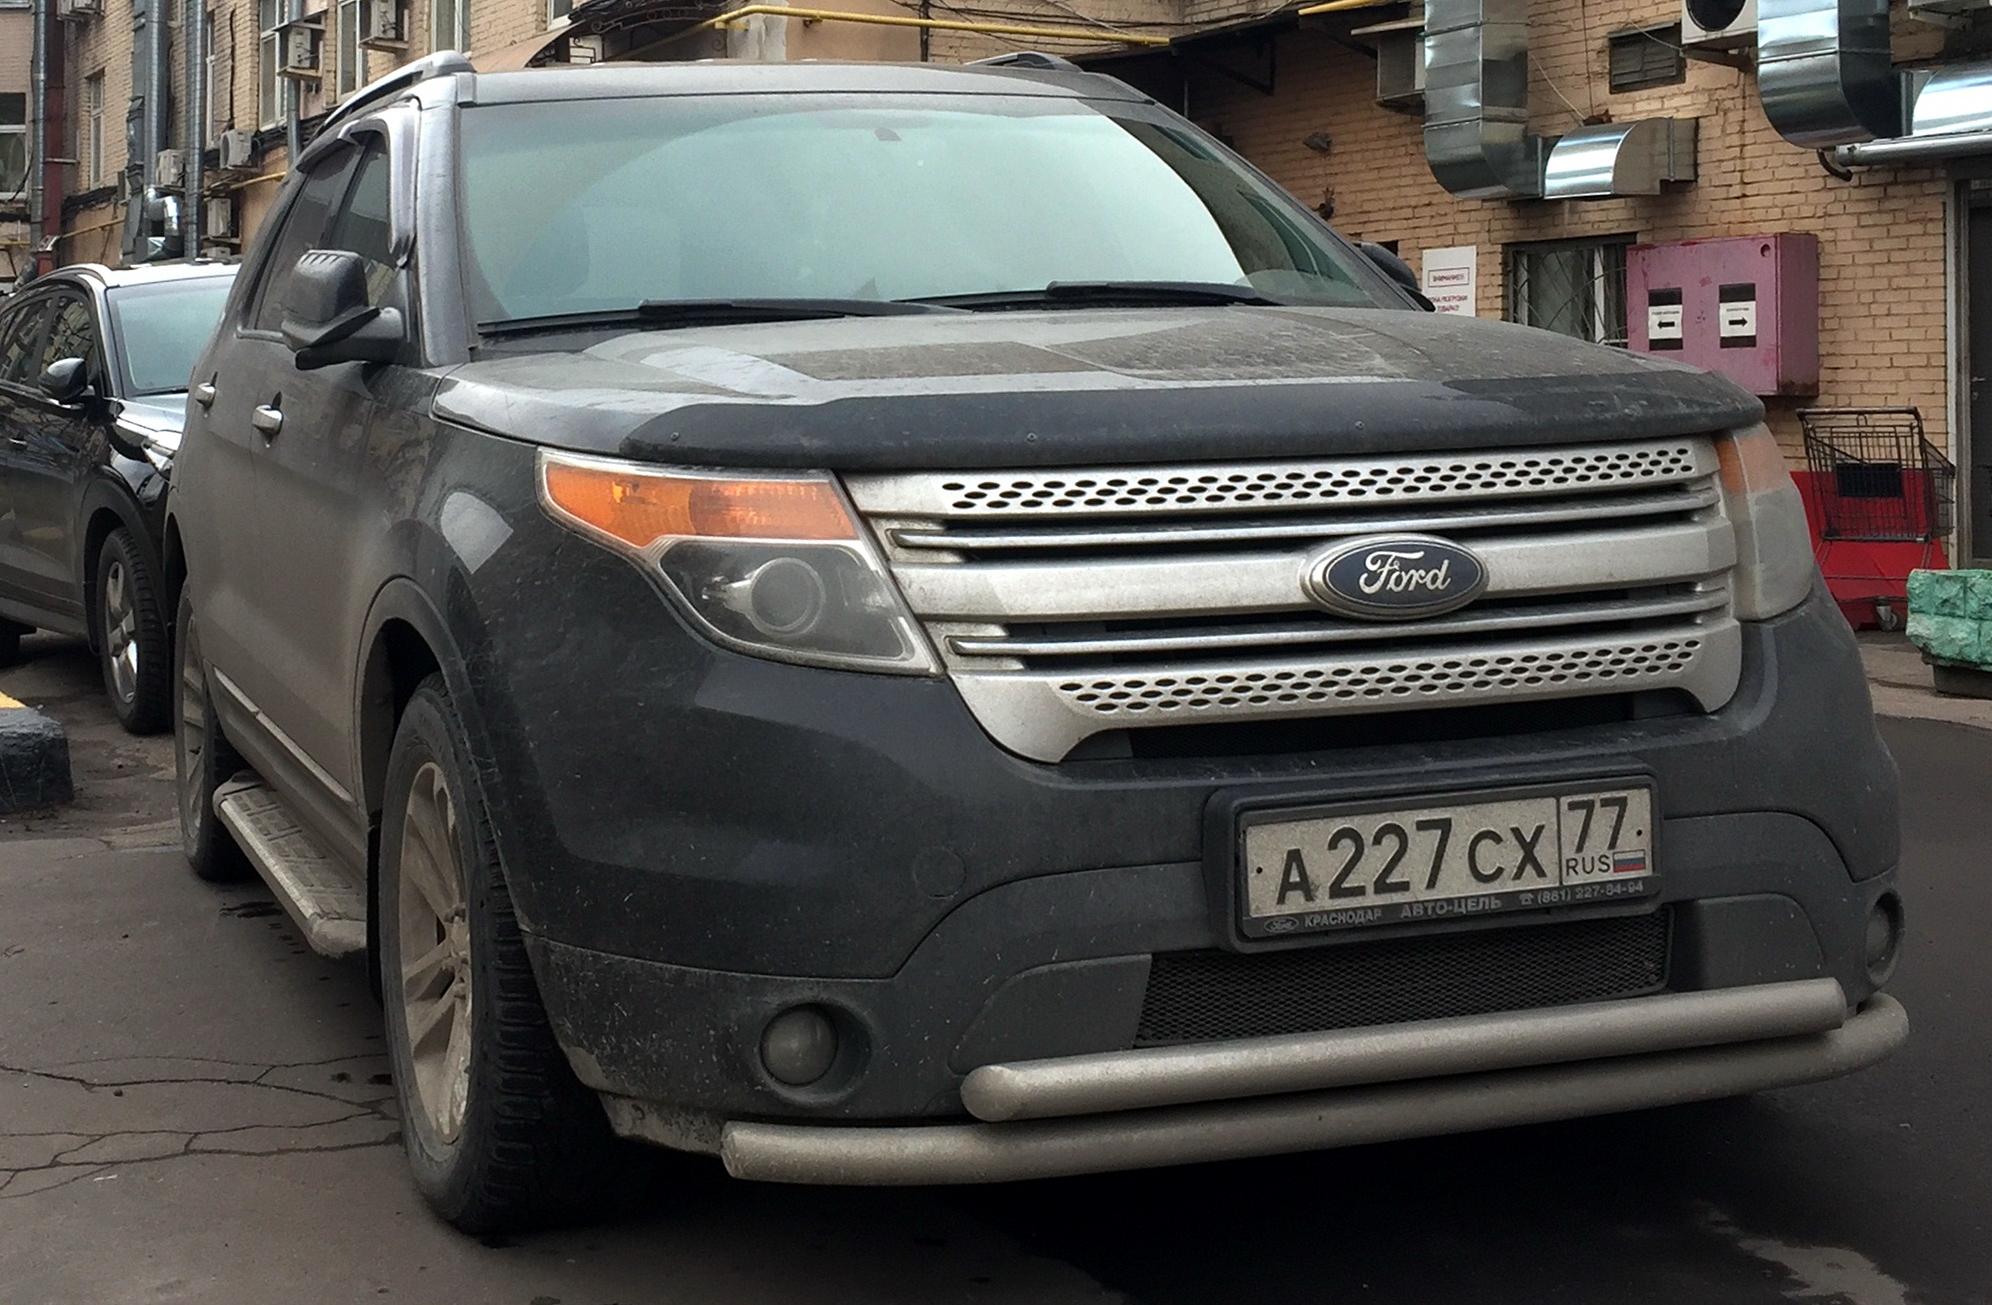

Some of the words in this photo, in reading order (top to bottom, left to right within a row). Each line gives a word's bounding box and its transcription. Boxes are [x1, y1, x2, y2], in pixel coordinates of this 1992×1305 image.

[1358, 550, 1452, 595] Ford
[1566, 796, 1629, 854] 77
[1565, 854, 1611, 877] RUS
[1304, 908, 1382, 928] КРАСНОДАР
[1400, 896, 1502, 920] АВТО-ЦЕЛЬ
